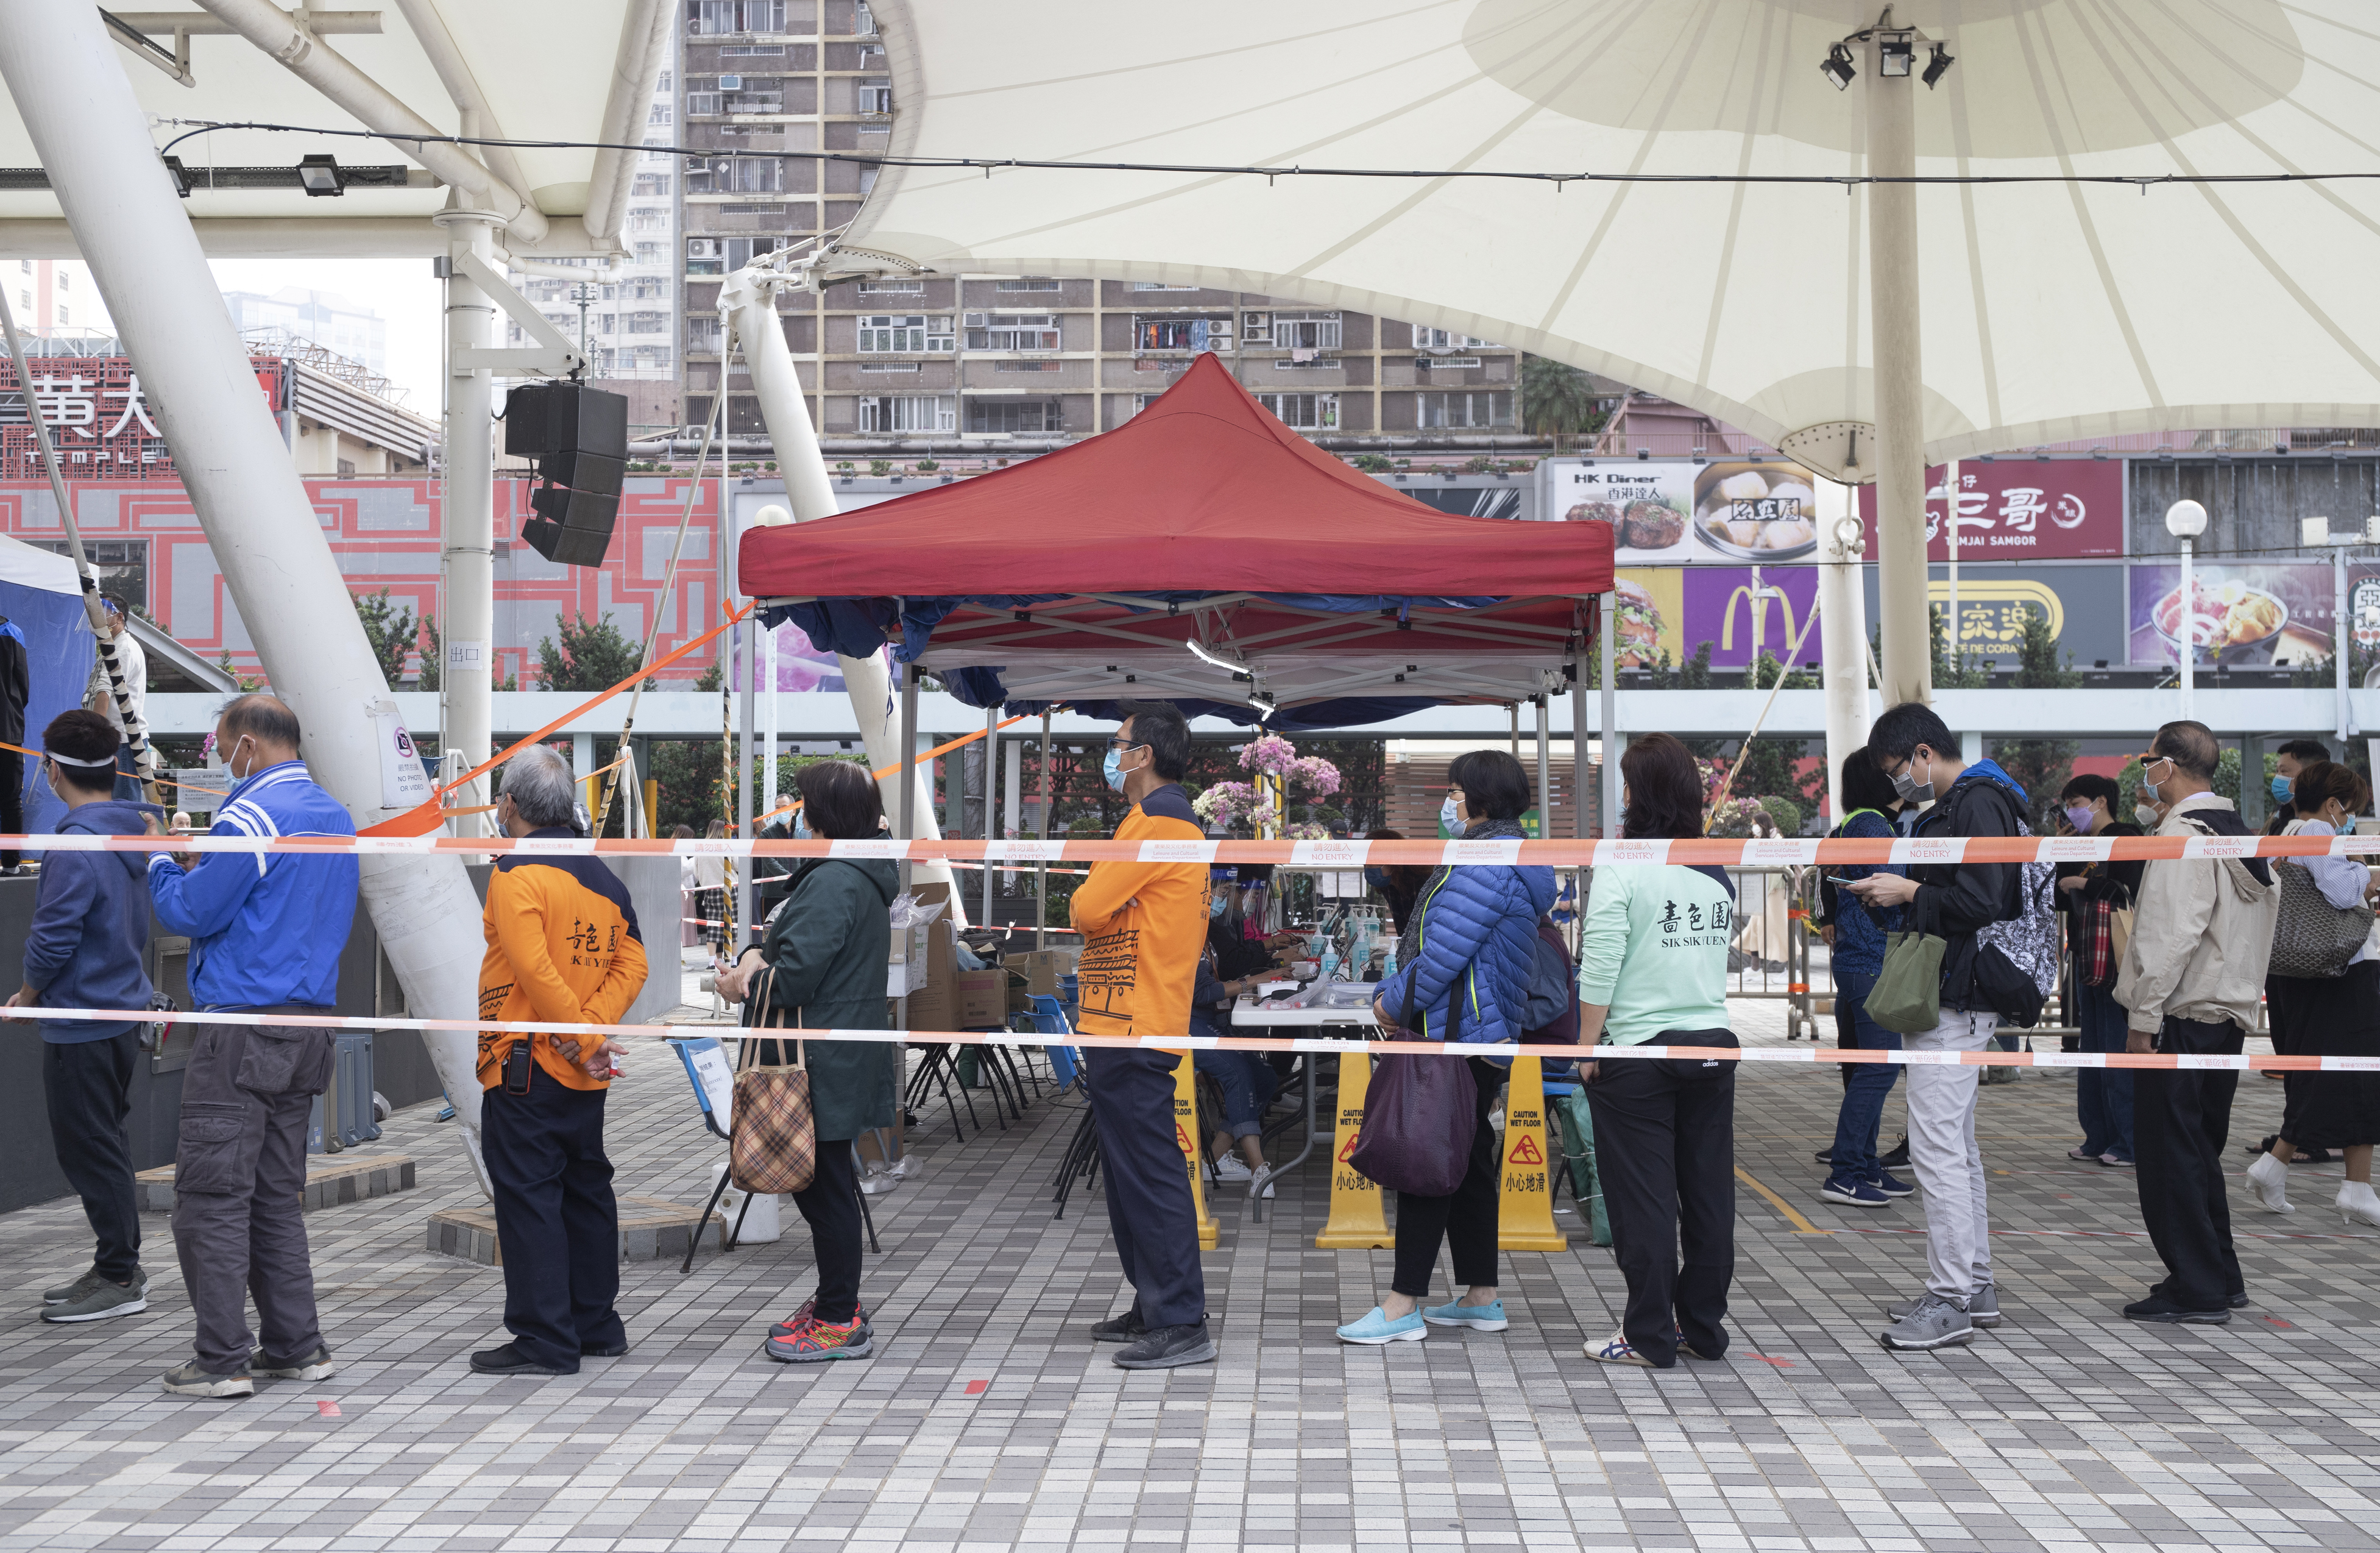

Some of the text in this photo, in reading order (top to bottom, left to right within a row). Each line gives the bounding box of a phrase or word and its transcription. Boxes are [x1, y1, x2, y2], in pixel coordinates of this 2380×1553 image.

[26, 452, 157, 464] TEMPLE
[1574, 474, 1662, 483] HK Diner
[1608, 488, 1660, 500] 香港達人
[1944, 488, 2047, 532] 三哥
[1944, 536, 2036, 546] TMJAI SAMGOR
[1970, 644, 1985, 653] DE
[1987, 644, 2027, 653] CORA
[451, 647, 478, 663] 出口
[695, 843, 733, 852] 請勿進入
[1007, 844, 1044, 852] 請勿進入
[1314, 843, 1351, 851] 請勿進入
[1662, 936, 1727, 948] SIK SIK YUEN
[2195, 1058, 2231, 1068] 請勿進入
[1506, 1172, 1545, 1192] 小心地滑
